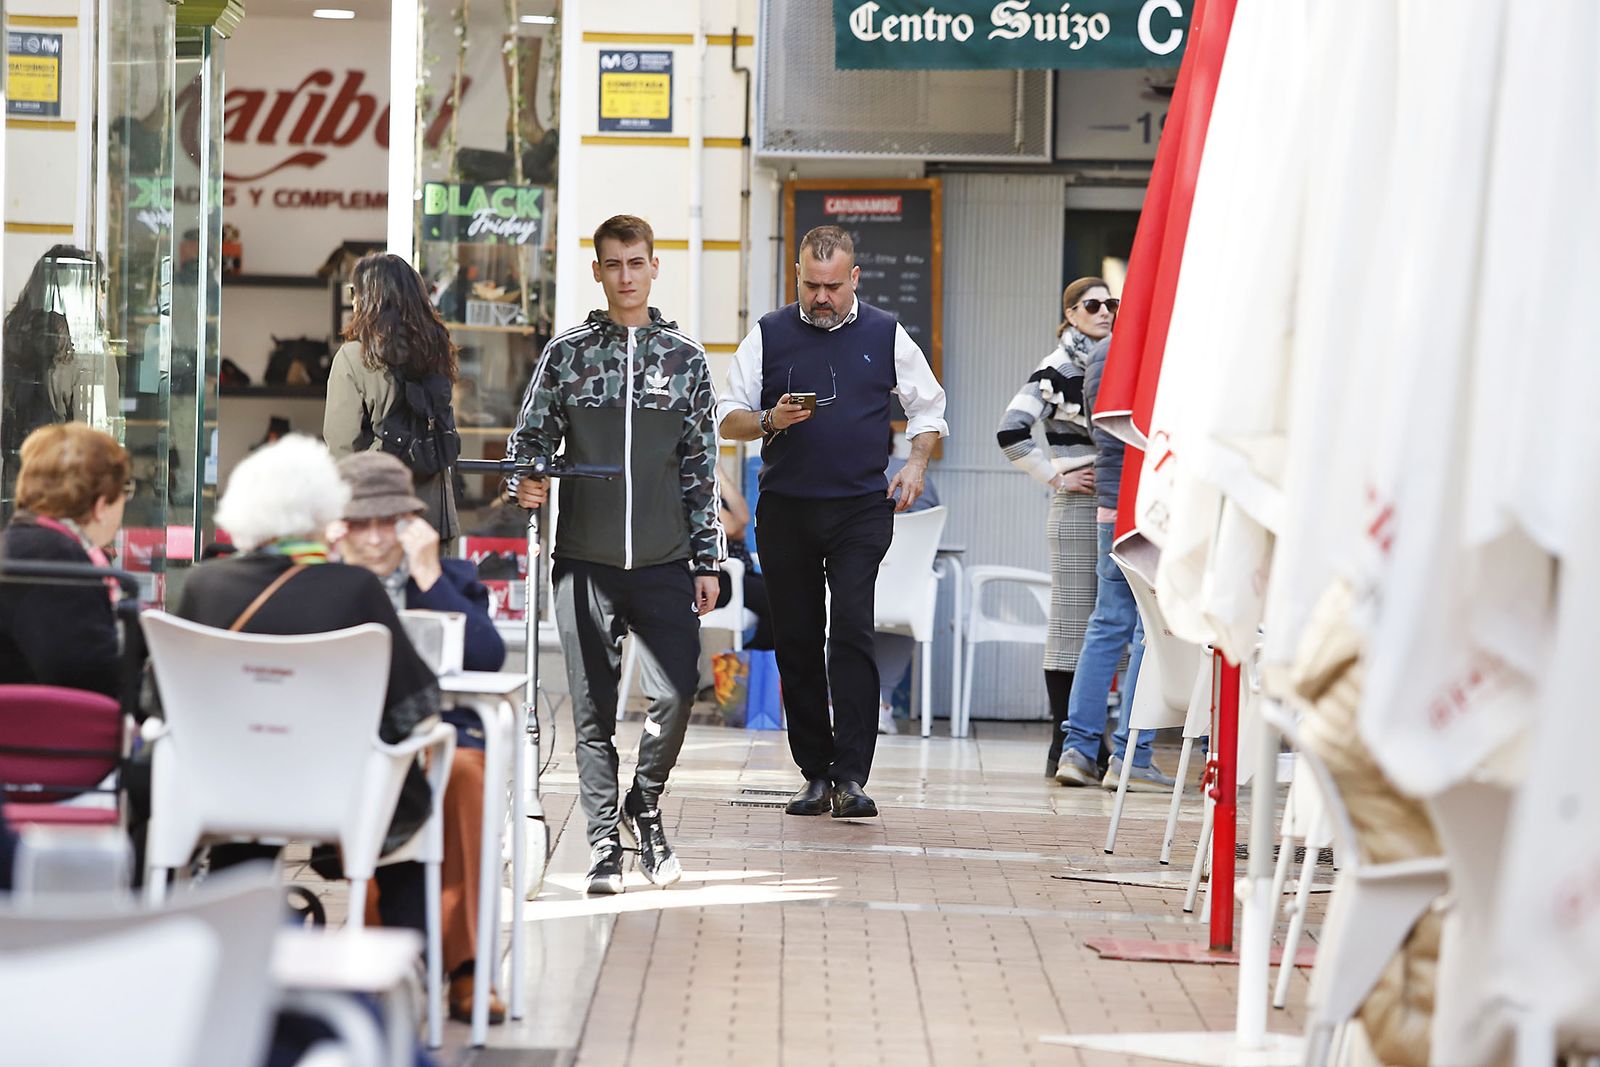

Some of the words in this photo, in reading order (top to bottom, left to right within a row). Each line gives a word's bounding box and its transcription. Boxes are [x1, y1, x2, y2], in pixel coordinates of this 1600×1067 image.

[849, 1, 975, 42] Centro
[424, 183, 544, 219] BLACK
[467, 207, 537, 245] Friday
[645, 387, 670, 396] adidas
